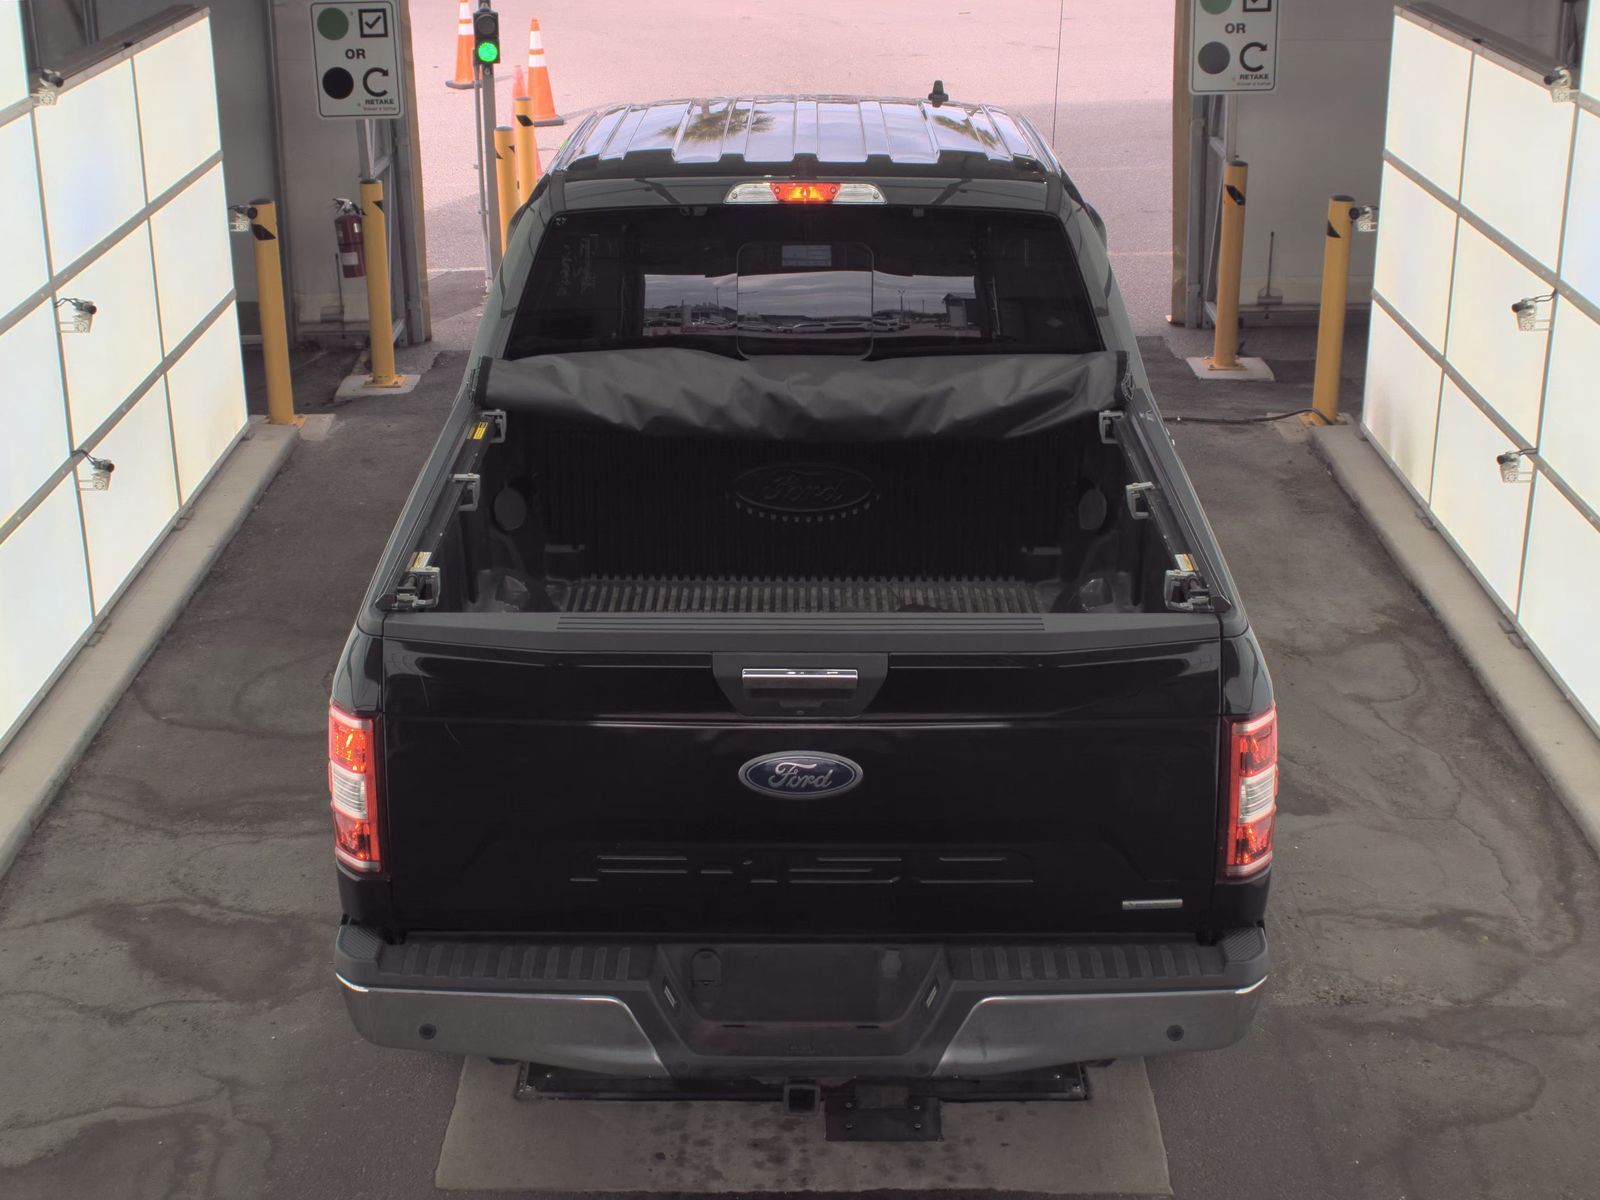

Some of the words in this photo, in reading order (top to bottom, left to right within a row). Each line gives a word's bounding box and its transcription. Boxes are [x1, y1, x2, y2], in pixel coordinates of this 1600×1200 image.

[1225, 23, 1246, 34] OR
[345, 48, 366, 59] OR
[768, 762, 834, 788] Ford
